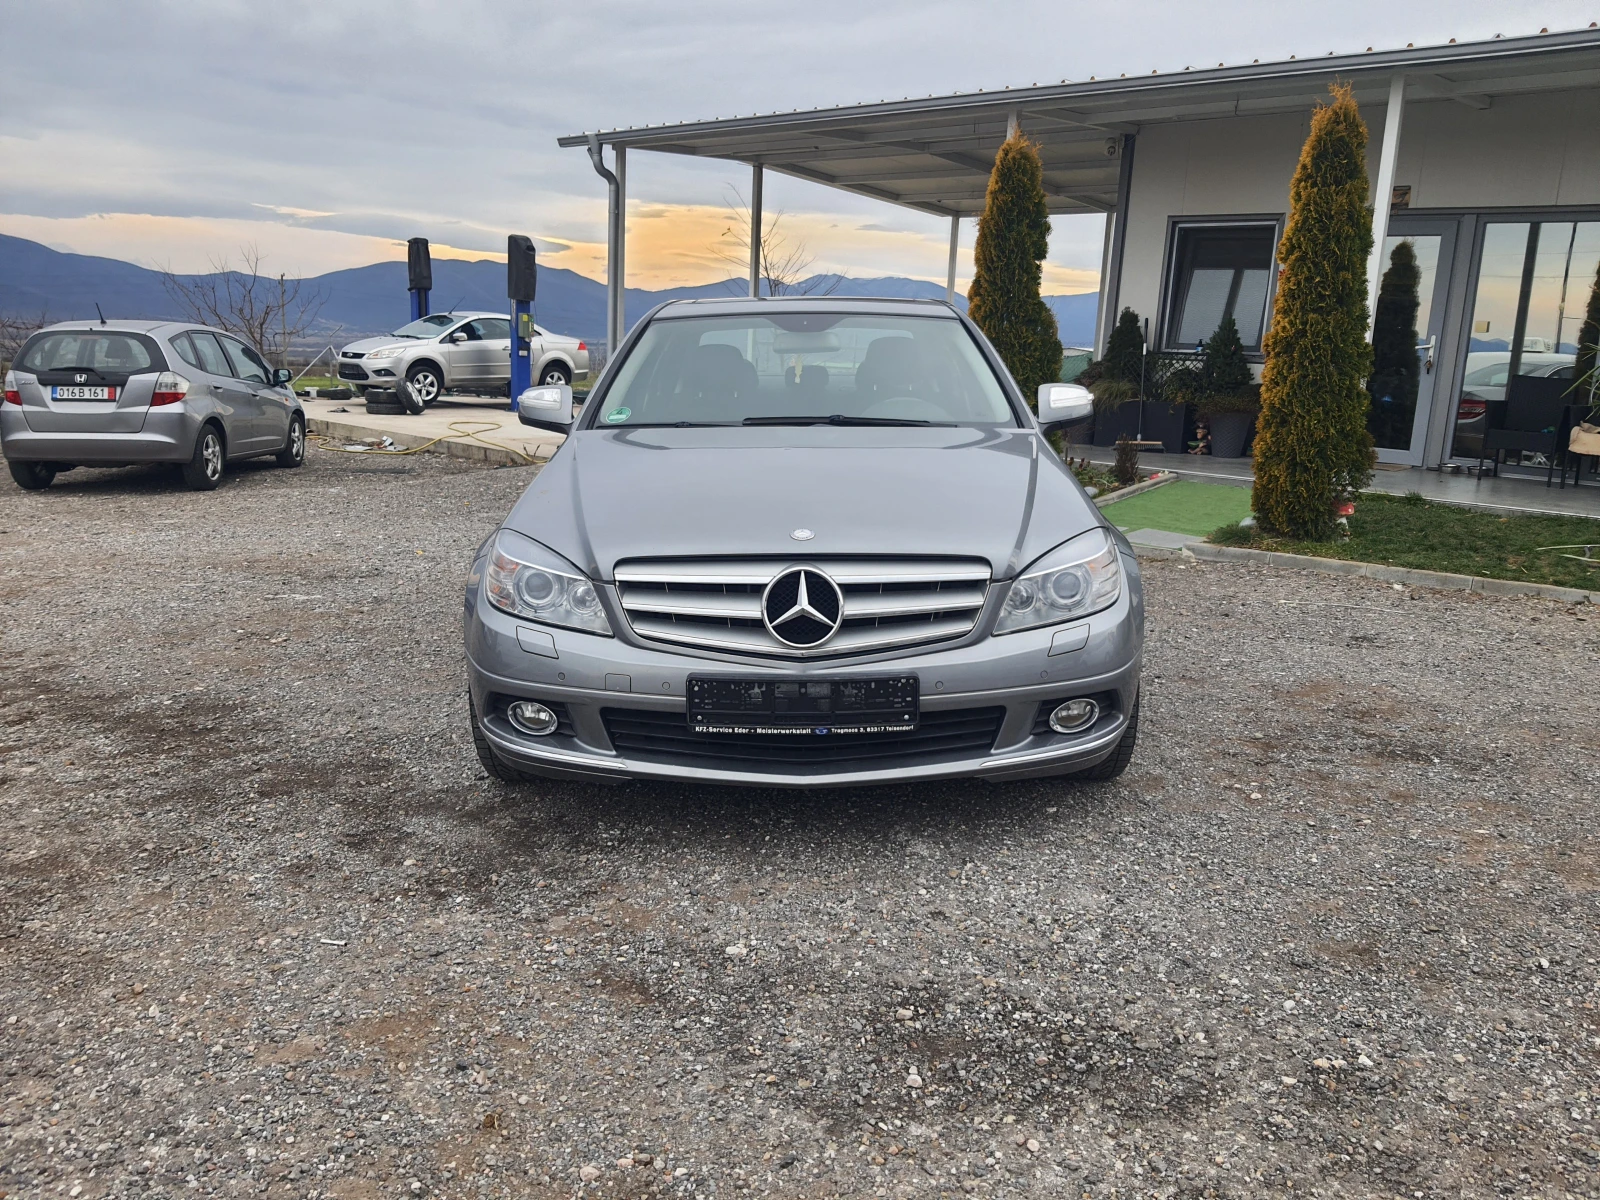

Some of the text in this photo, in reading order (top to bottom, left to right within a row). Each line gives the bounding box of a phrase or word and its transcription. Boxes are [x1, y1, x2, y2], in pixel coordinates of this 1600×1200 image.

[59, 388, 104, 398] 016 B 161
